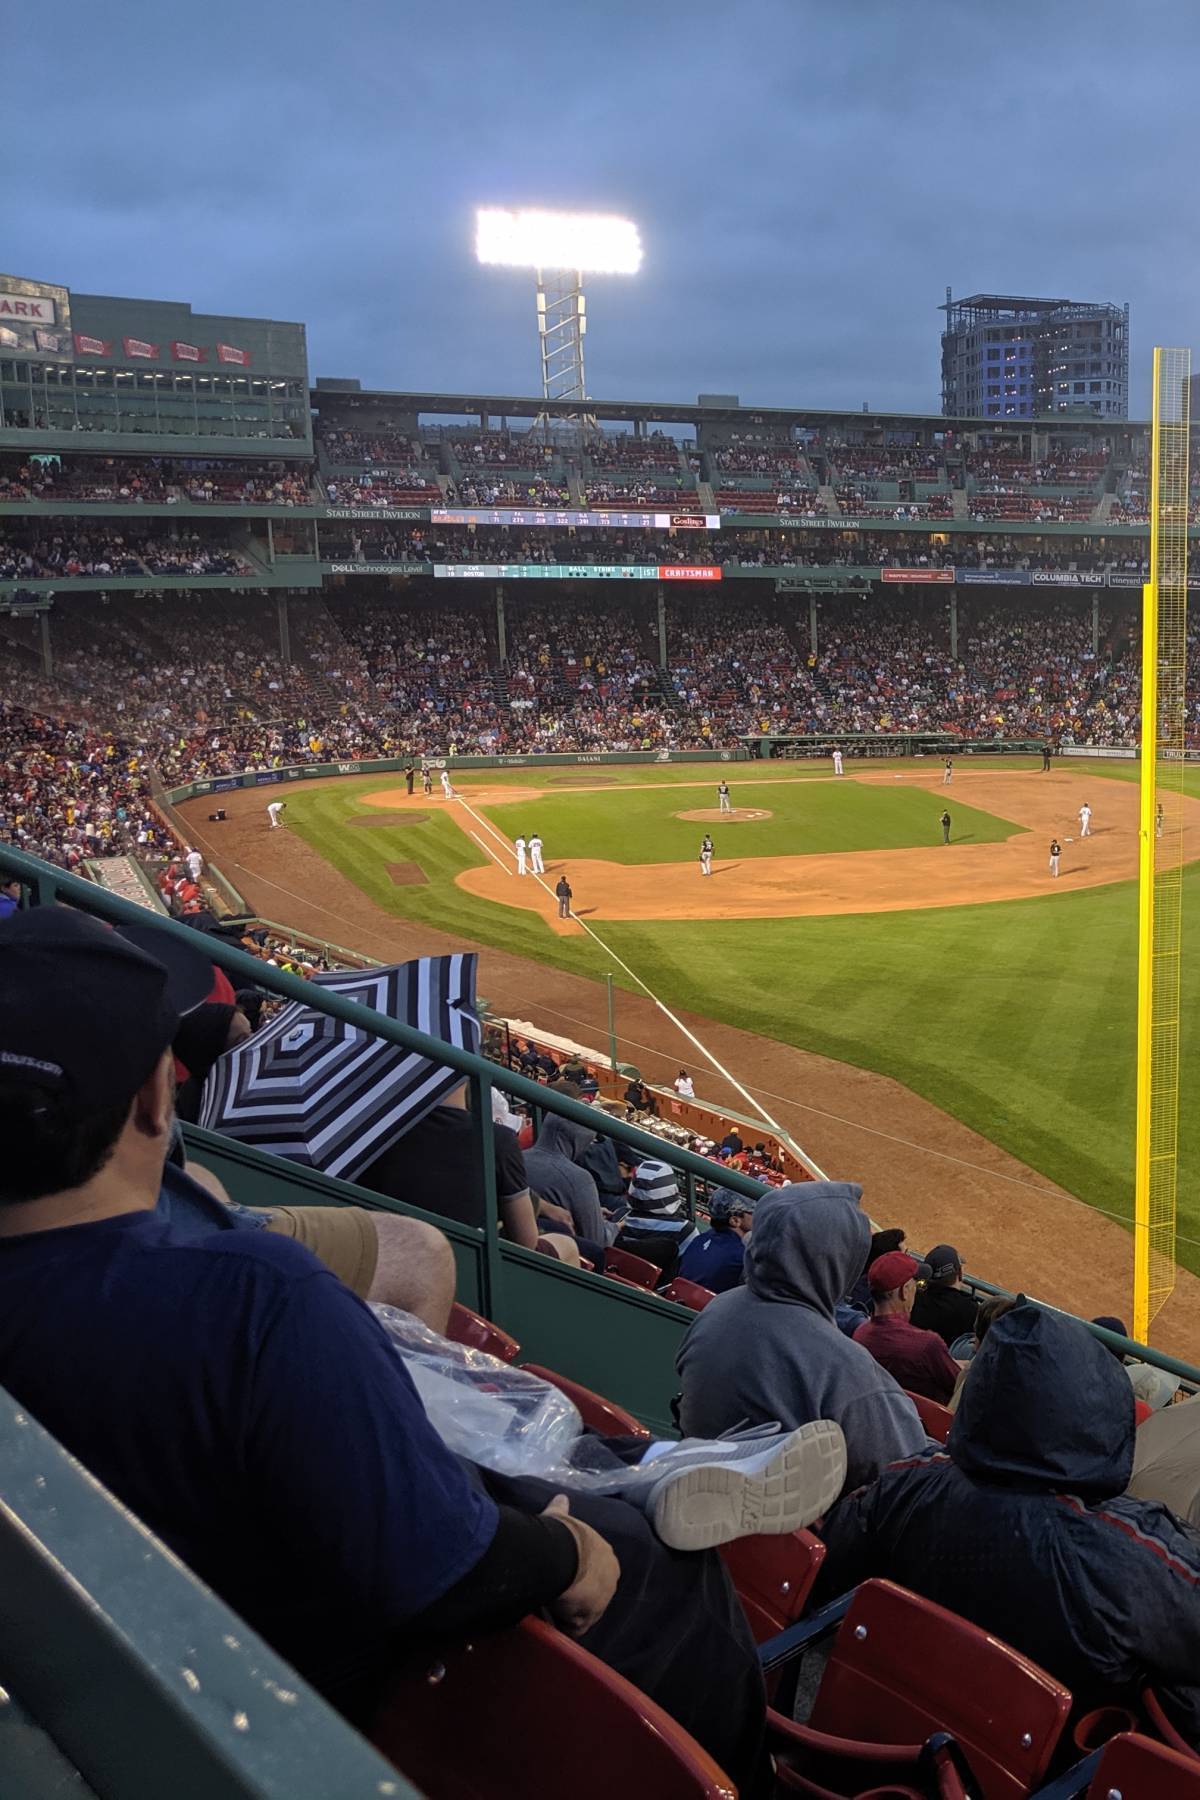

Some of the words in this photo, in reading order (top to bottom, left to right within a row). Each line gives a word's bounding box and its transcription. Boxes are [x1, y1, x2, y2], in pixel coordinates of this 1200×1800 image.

[326, 509, 349, 518] STATE
[350, 510, 379, 519] STREET
[382, 511, 420, 519] PAVILION
[801, 519, 825, 527] STREET
[827, 520, 860, 528] PAVILION
[355, 565, 400, 574] Technologies
[403, 565, 423, 573] Level
[665, 569, 714, 577] CRAFTSMAN
[1034, 573, 1079, 582] COLUMBIA
[1080, 575, 1102, 583] TECH
[1112, 577, 1141, 585] vineyard
